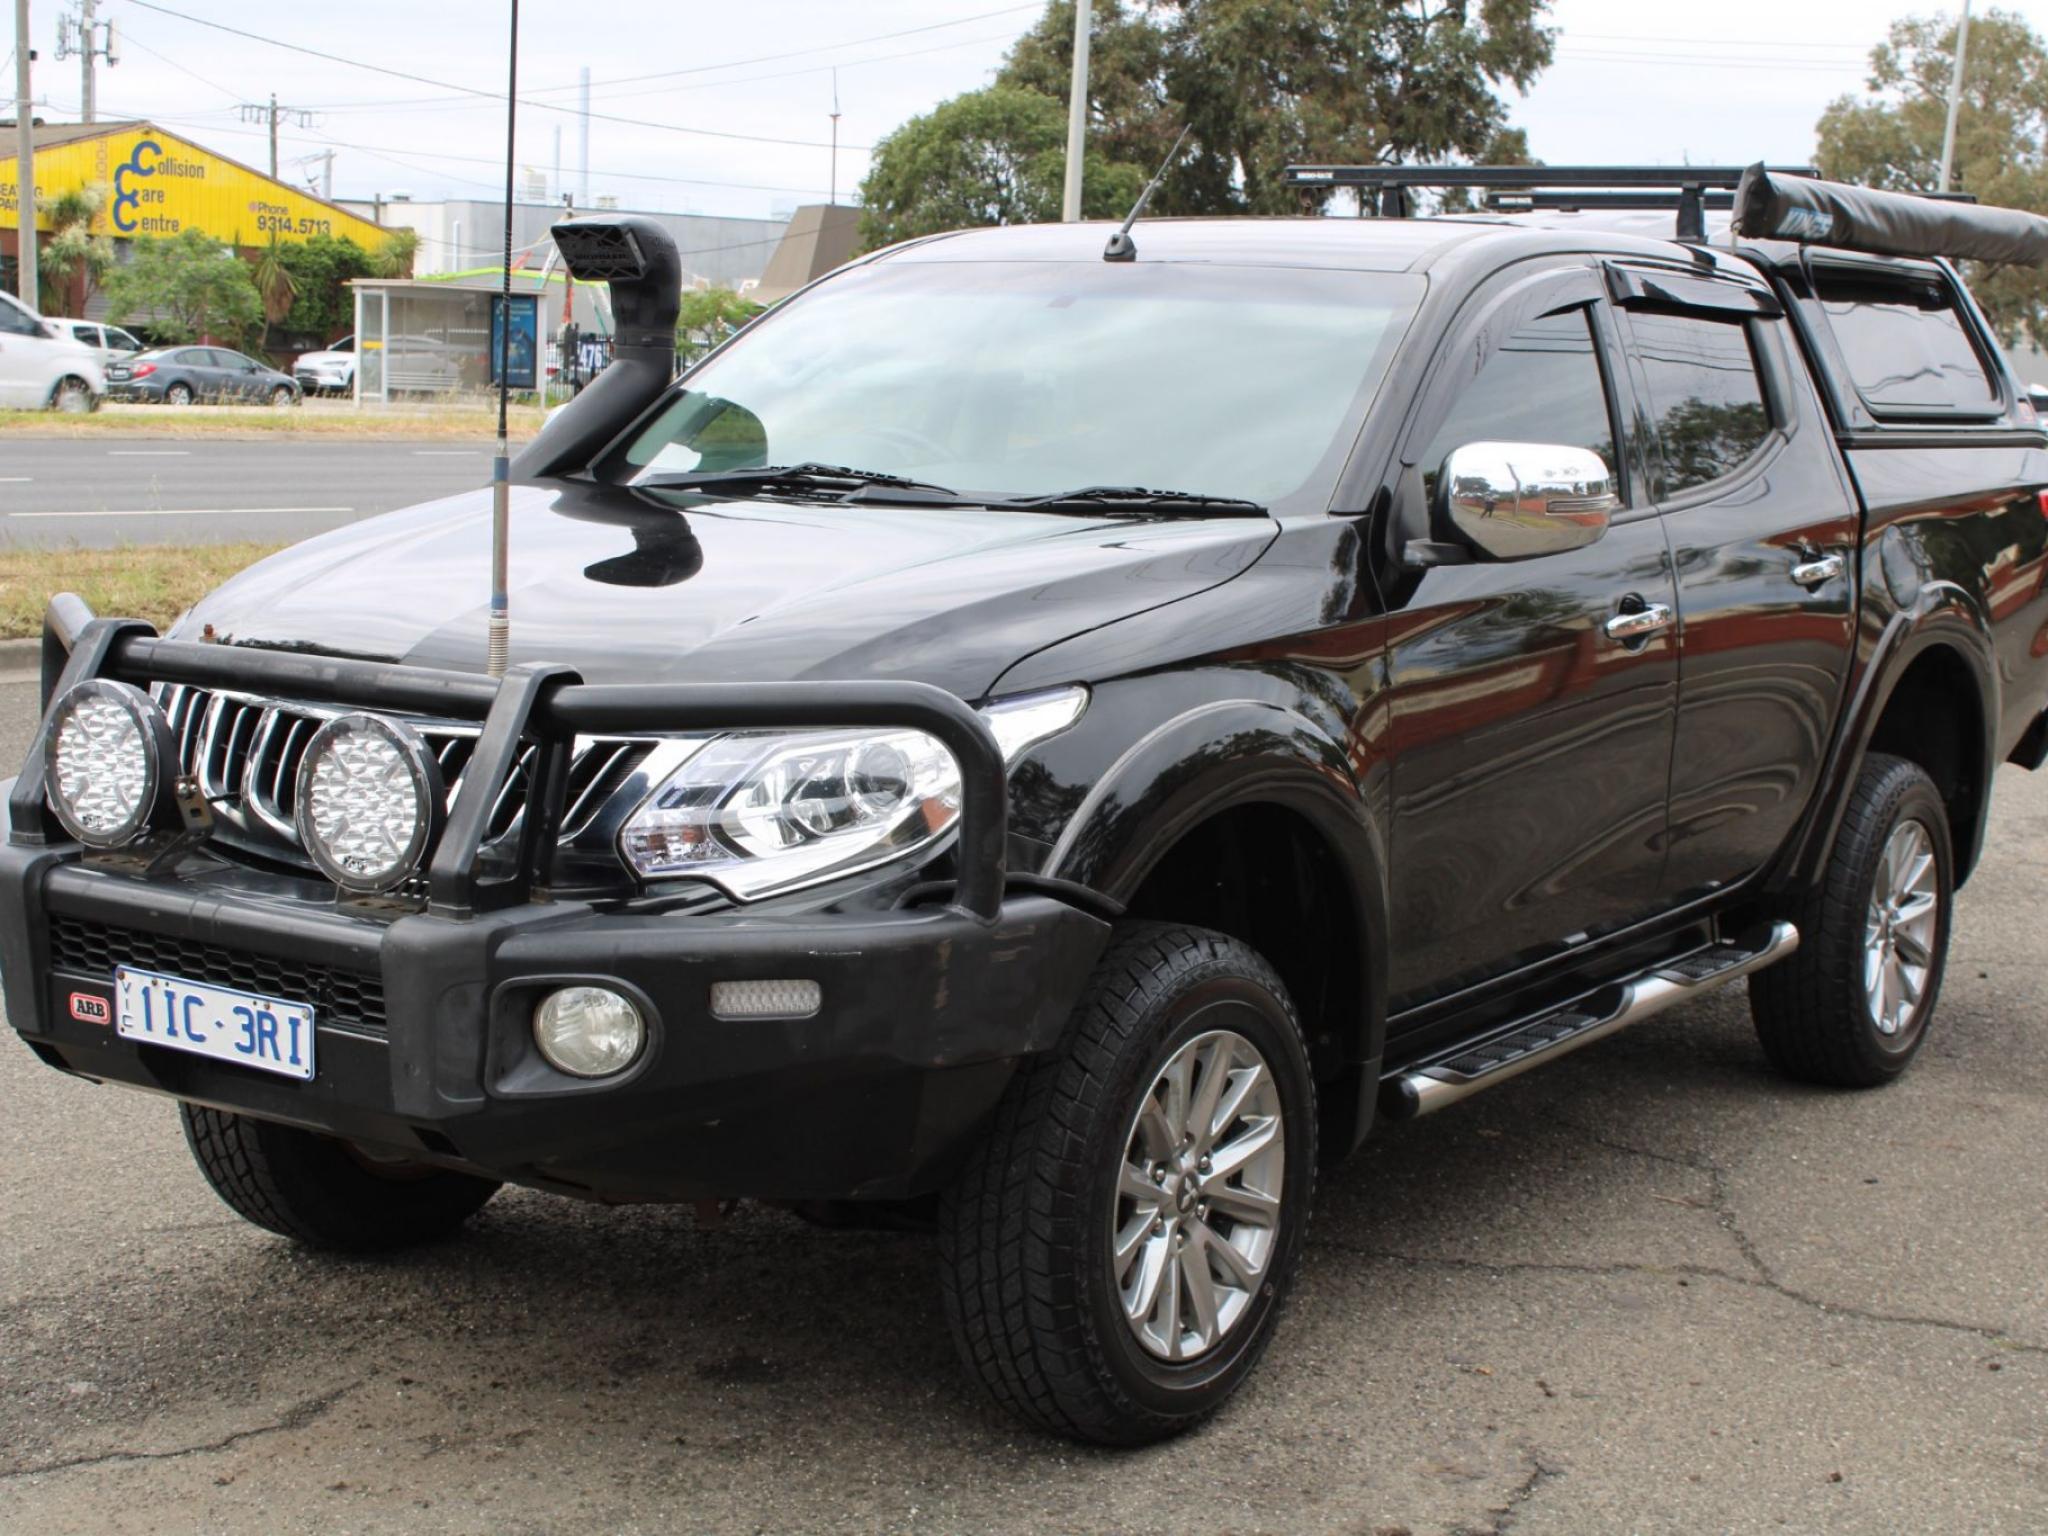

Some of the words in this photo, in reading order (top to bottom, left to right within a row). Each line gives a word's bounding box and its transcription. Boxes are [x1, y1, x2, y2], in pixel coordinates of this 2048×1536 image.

[131, 141, 205, 179] Collision
[114, 163, 165, 204] Care
[113, 196, 180, 233] Centre
[258, 202, 289, 216] Phone
[76, 999, 105, 1017] ARB
